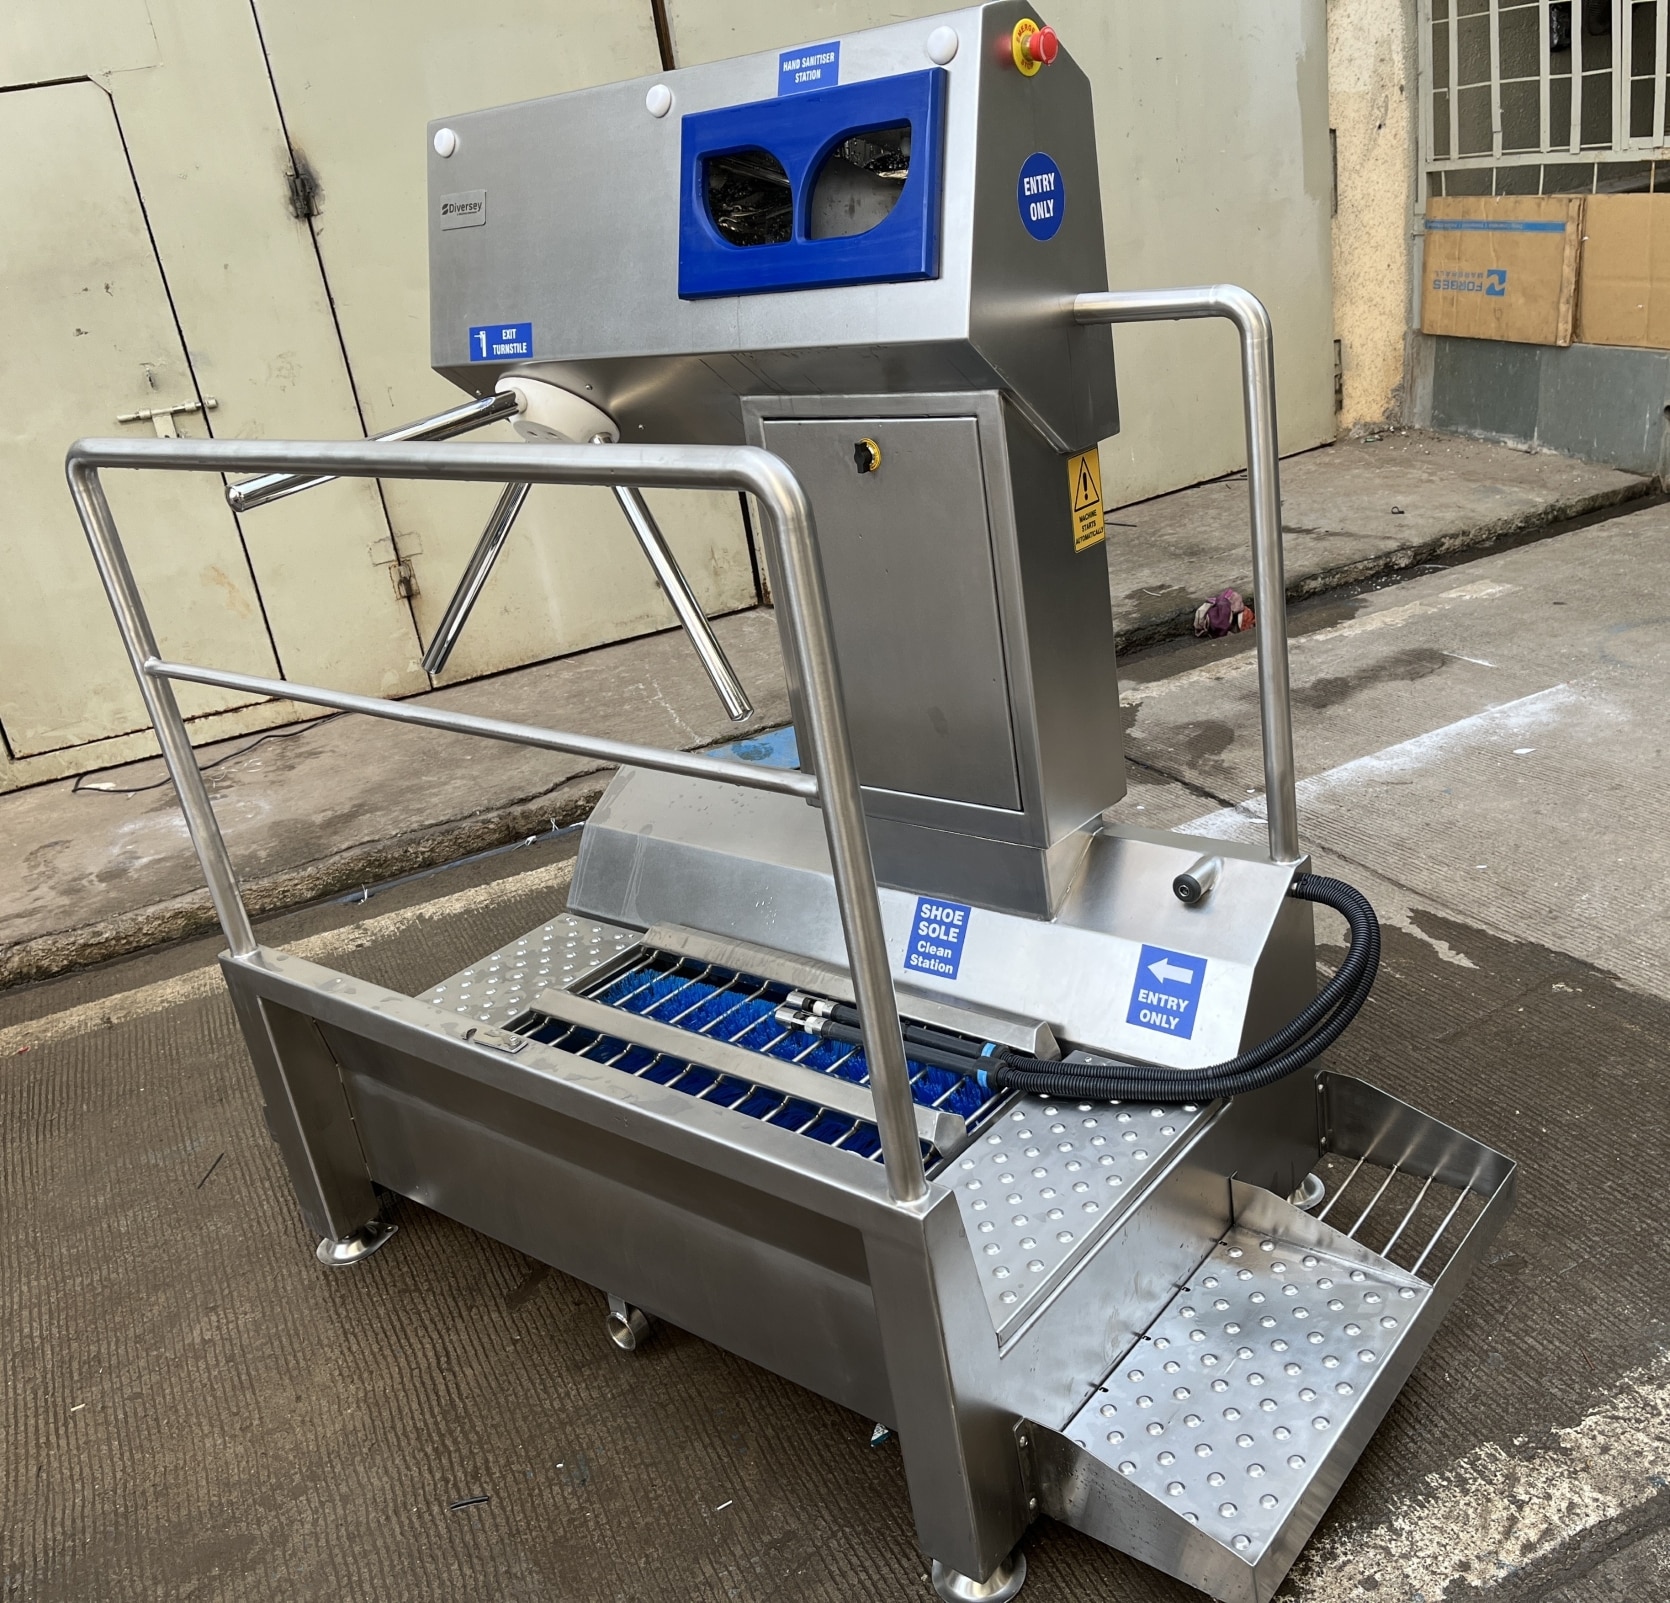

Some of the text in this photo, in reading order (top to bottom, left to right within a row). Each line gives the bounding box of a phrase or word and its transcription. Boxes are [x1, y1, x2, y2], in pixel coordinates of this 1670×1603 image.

[783, 51, 835, 72] HAND SANITISER
[794, 68, 821, 83] STATION
[1023, 172, 1055, 196] ENTRY
[448, 201, 482, 214] Diversey
[1029, 198, 1054, 221] ONLY
[1432, 279, 1483, 292] FORBES
[502, 328, 517, 340] EXIT
[492, 342, 528, 356] TURNSTILE
[1079, 509, 1097, 523] MACHINE
[1075, 526, 1104, 545] AUTOMATICALLY
[1081, 520, 1096, 533] STARTS
[920, 903, 965, 926] SHOE
[918, 920, 960, 943] SOLE
[917, 940, 953, 959] Clean
[909, 953, 954, 975] Station
[1137, 988, 1190, 1013] ENTRY
[1139, 1008, 1180, 1031] ONLY
